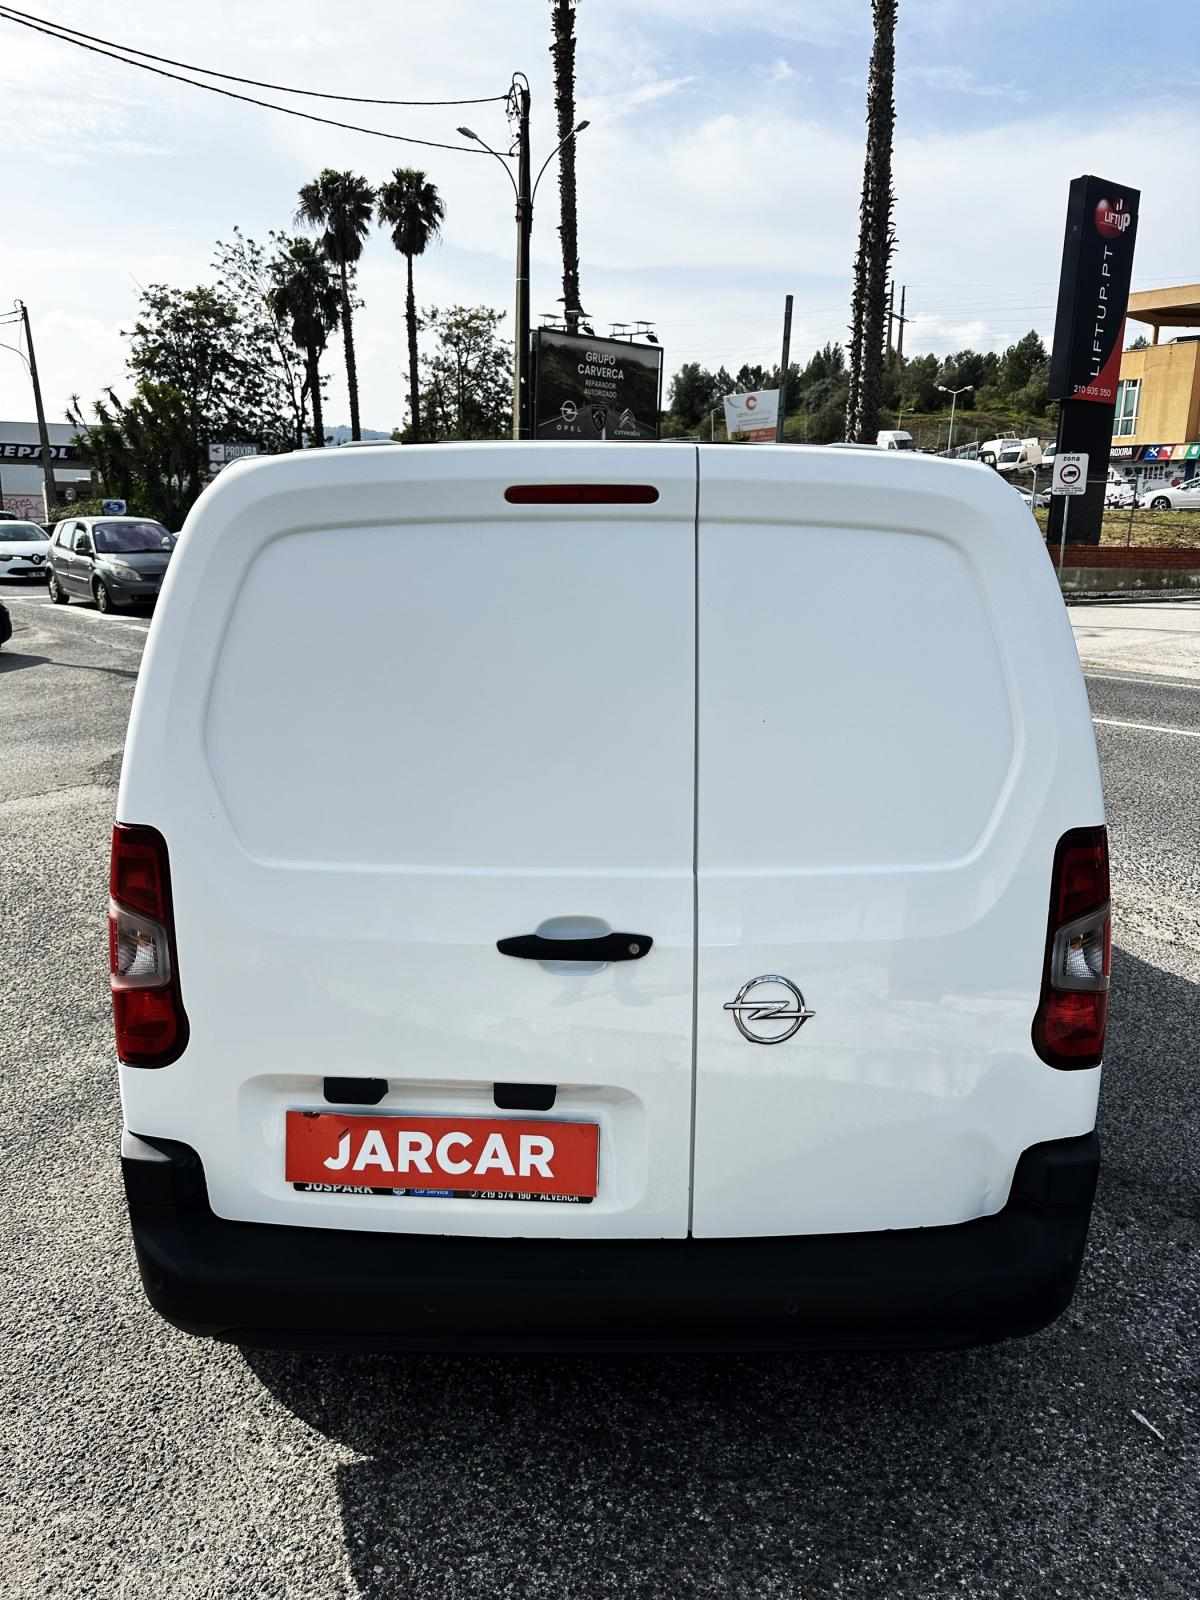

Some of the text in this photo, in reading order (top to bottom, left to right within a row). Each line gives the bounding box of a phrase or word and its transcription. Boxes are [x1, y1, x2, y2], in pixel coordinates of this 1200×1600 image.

[585, 351, 616, 366] GRUPO
[577, 365, 624, 380] CARVERCA
[1073, 384, 1086, 394] 210
[555, 424, 582, 433] OPEL
[1109, 447, 1133, 457] ROXIRA
[322, 1129, 555, 1179] JARCAR
